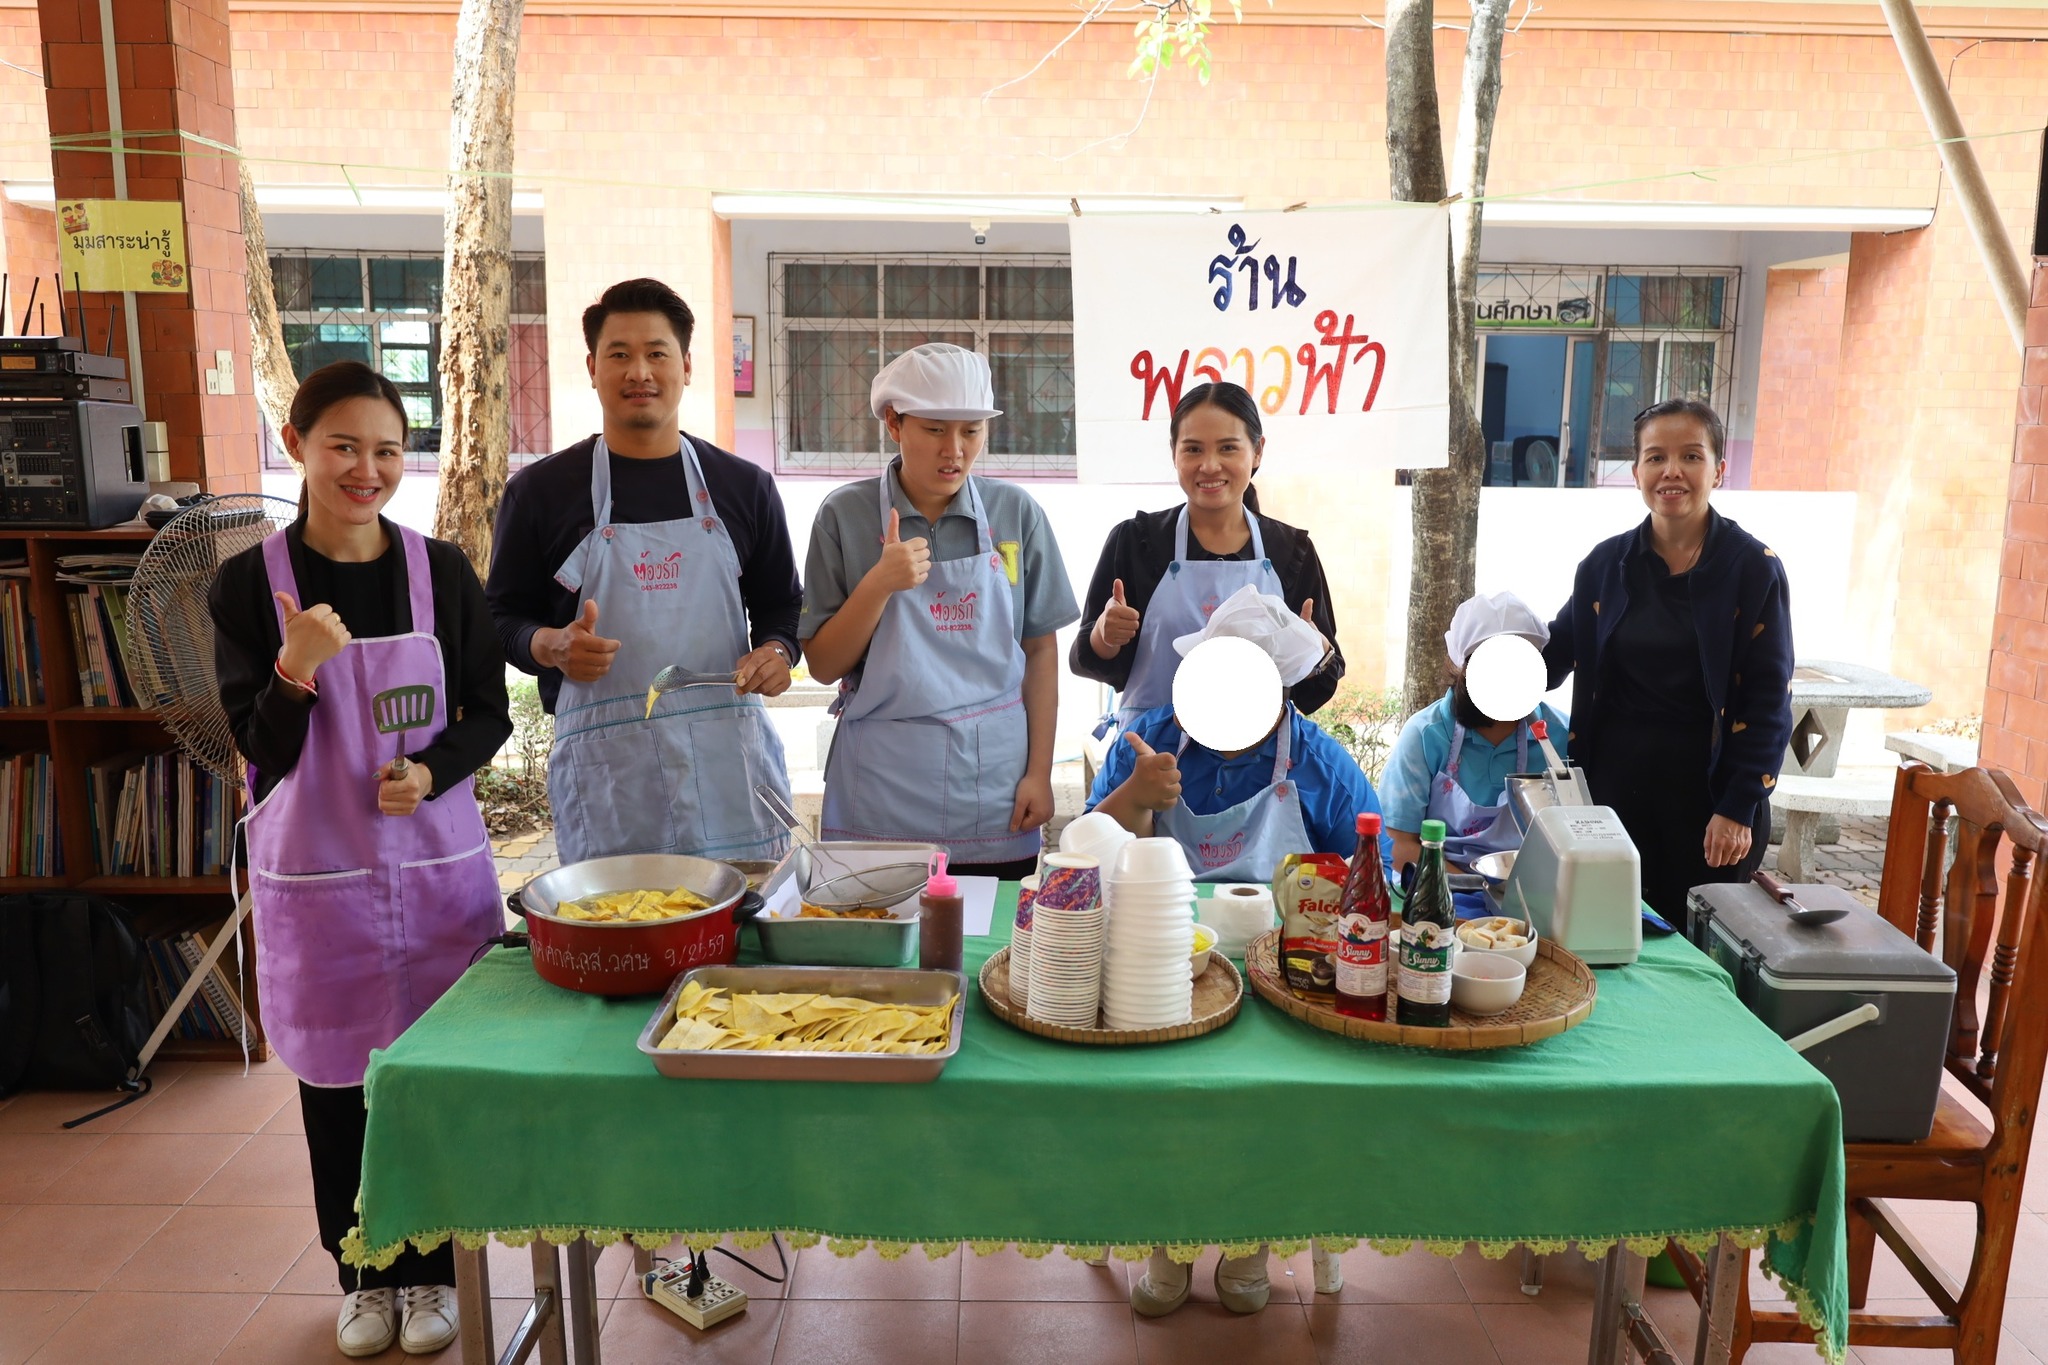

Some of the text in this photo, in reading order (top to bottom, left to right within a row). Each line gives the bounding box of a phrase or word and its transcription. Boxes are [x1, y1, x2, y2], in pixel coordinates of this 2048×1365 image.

[73, 229, 171, 258] มุมสาระน่ารู้
[1208, 223, 1307, 311] ร้าน
[1343, 945, 1372, 961] Sunny
[1409, 952, 1440, 969] Sunny
